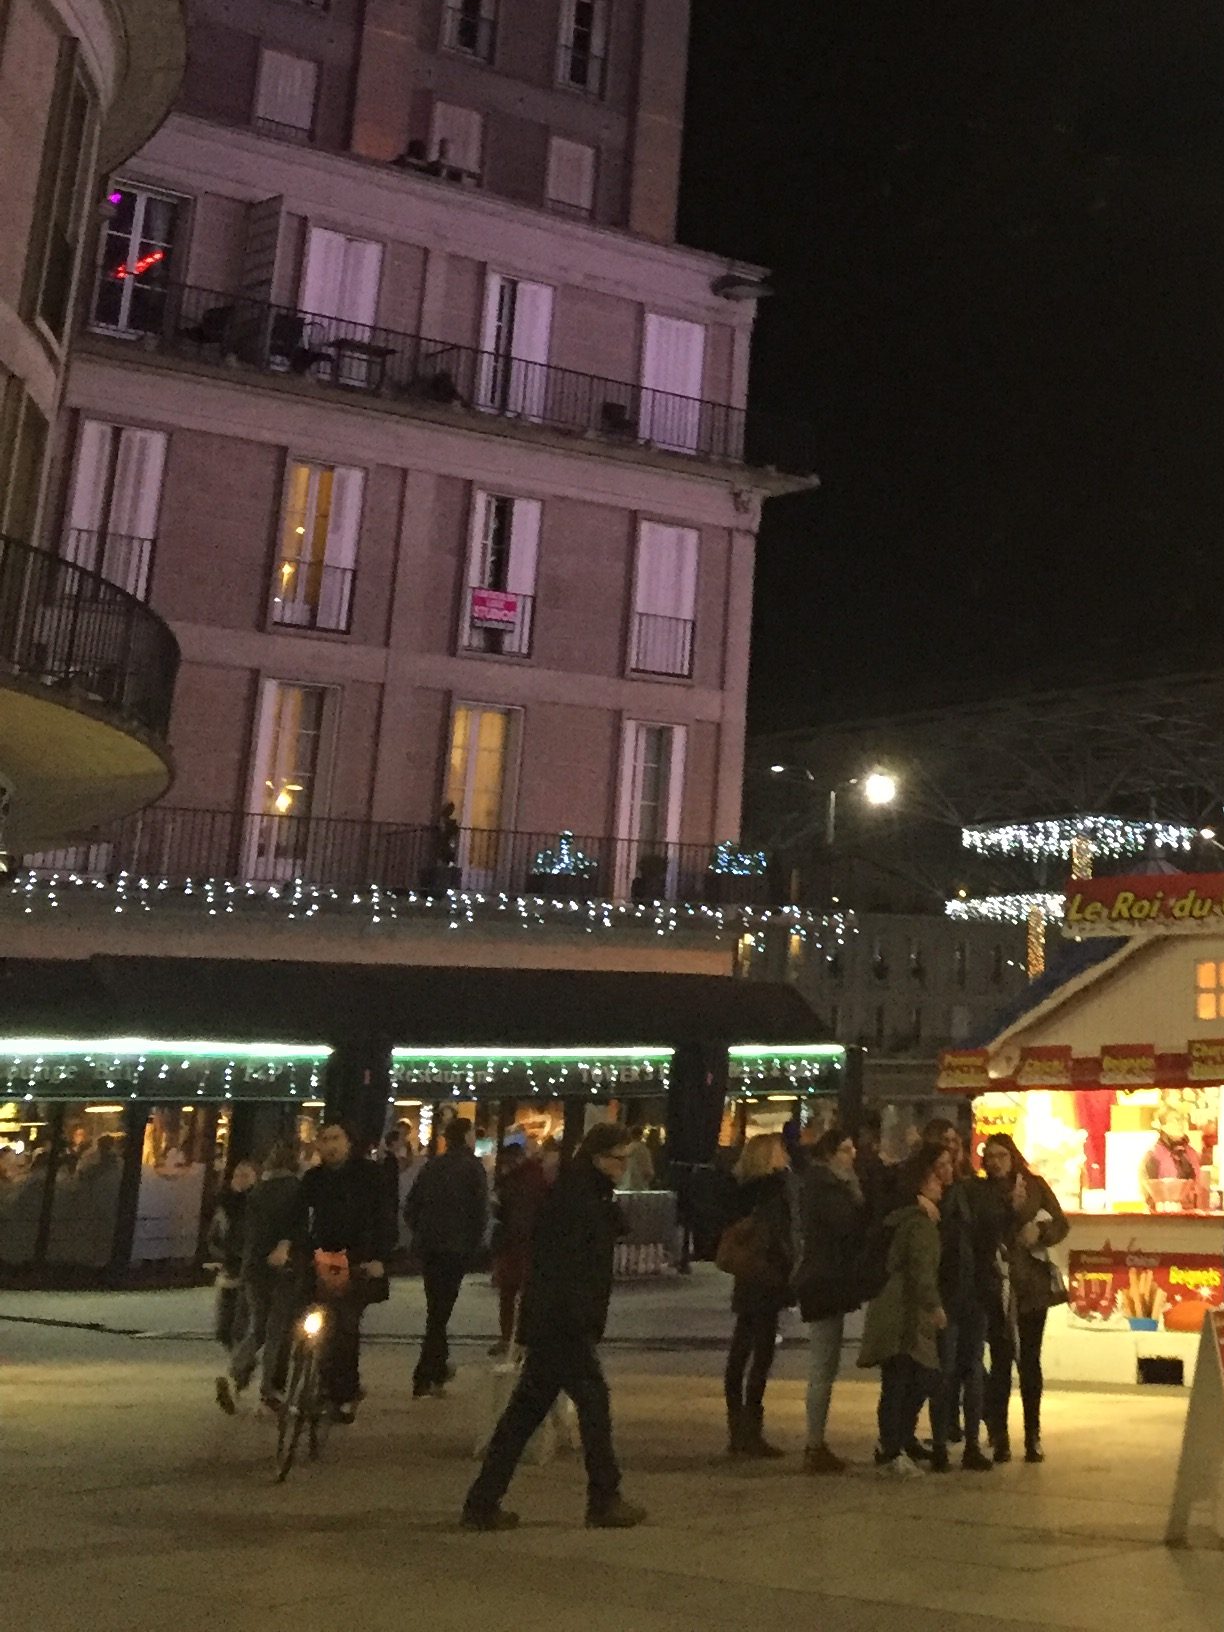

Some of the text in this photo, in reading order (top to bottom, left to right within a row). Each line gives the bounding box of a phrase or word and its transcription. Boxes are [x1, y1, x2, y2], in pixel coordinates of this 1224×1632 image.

[1066, 893, 1102, 921] Le
[1111, 890, 1165, 918] Roi
[1171, 889, 1213, 918] du
